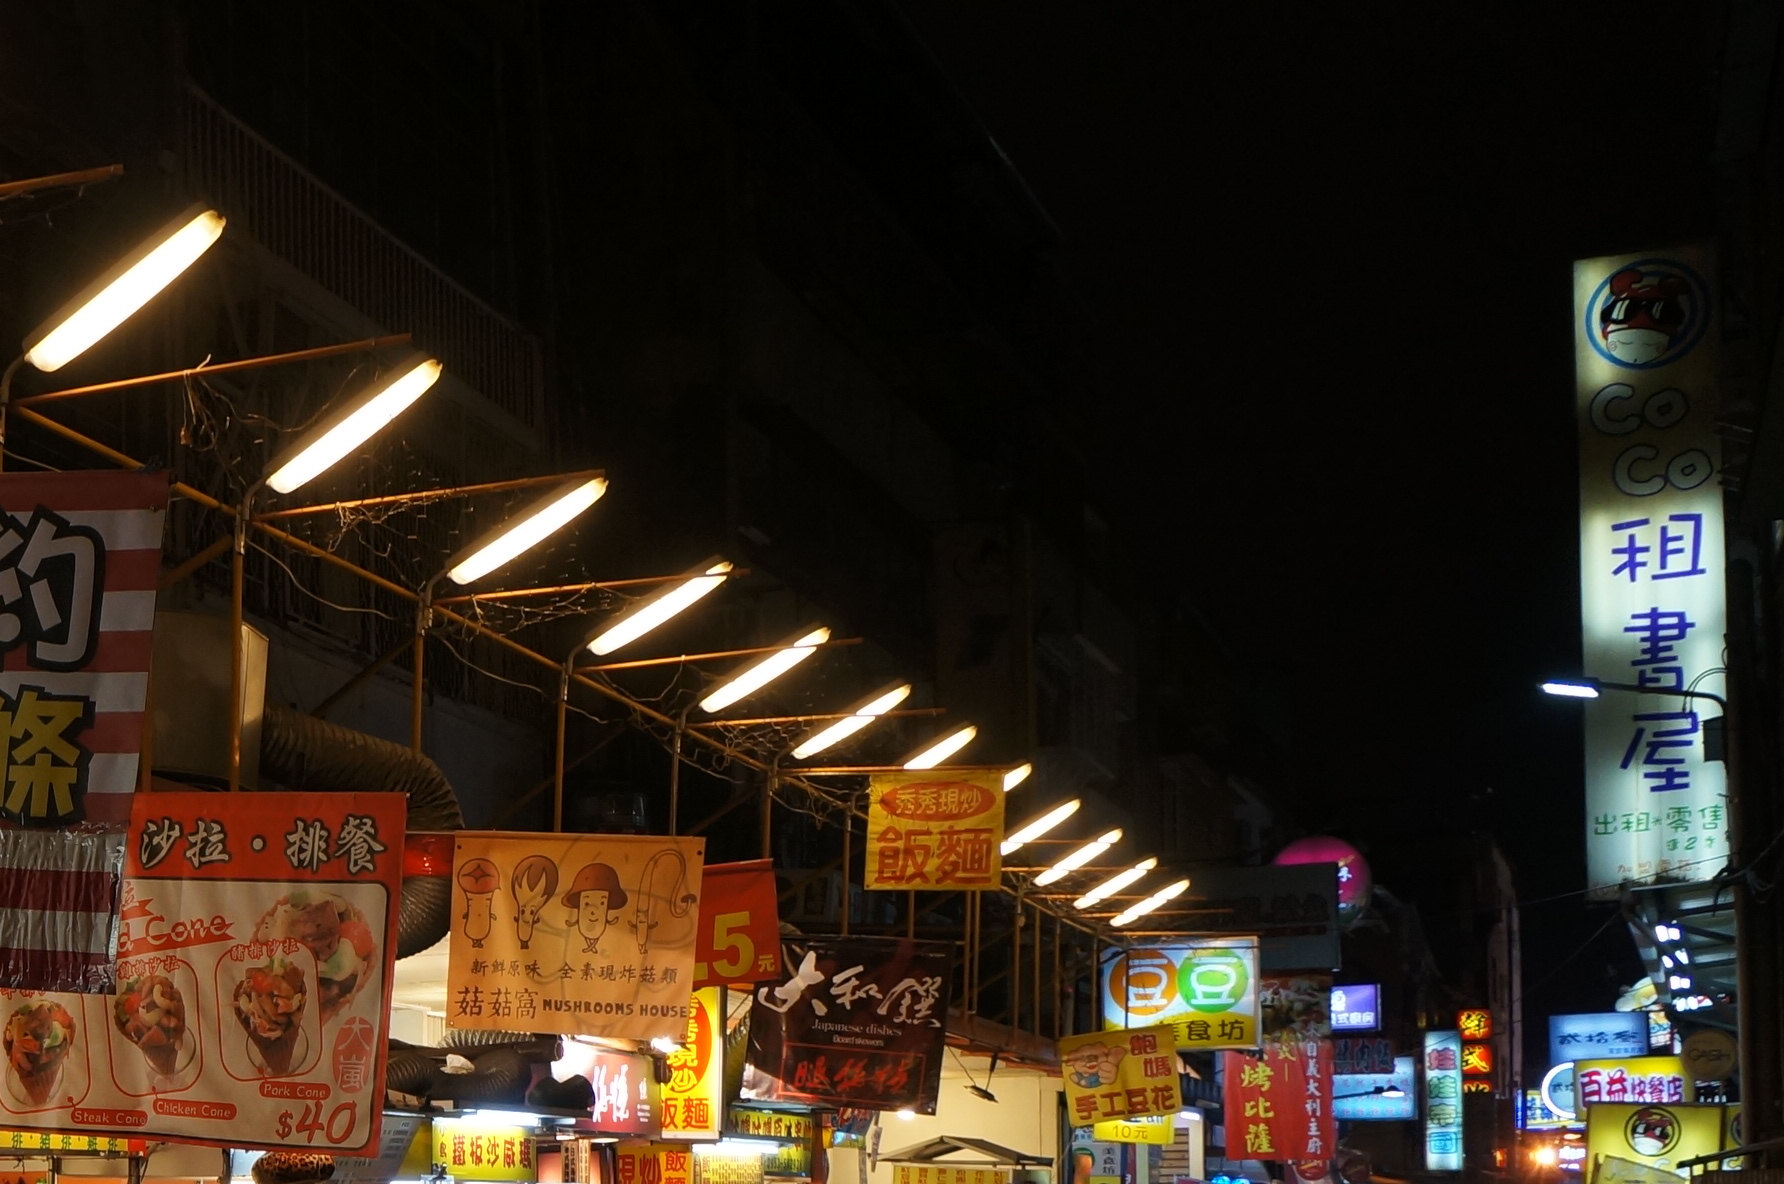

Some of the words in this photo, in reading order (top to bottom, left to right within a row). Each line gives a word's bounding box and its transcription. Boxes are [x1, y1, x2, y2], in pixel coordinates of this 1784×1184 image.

[1610, 511, 1708, 794] 租書屋
[875, 824, 993, 886] 飯麵
[453, 986, 539, 1020] 菇菇窩
[638, 1003, 689, 1019] HOUSE
[811, 1019, 864, 1034] Japanese
[865, 1020, 903, 1037] dishes
[263, 1083, 291, 1098] Pork
[296, 1085, 326, 1099] Cone
[1074, 1085, 1176, 1120] 手工豆花
[1239, 1049, 1276, 1154] 烤比薩
[73, 1110, 110, 1125] Steak
[156, 1100, 197, 1117] Chicken
[200, 1104, 231, 1118] Cone
[275, 1099, 357, 1146] $40
